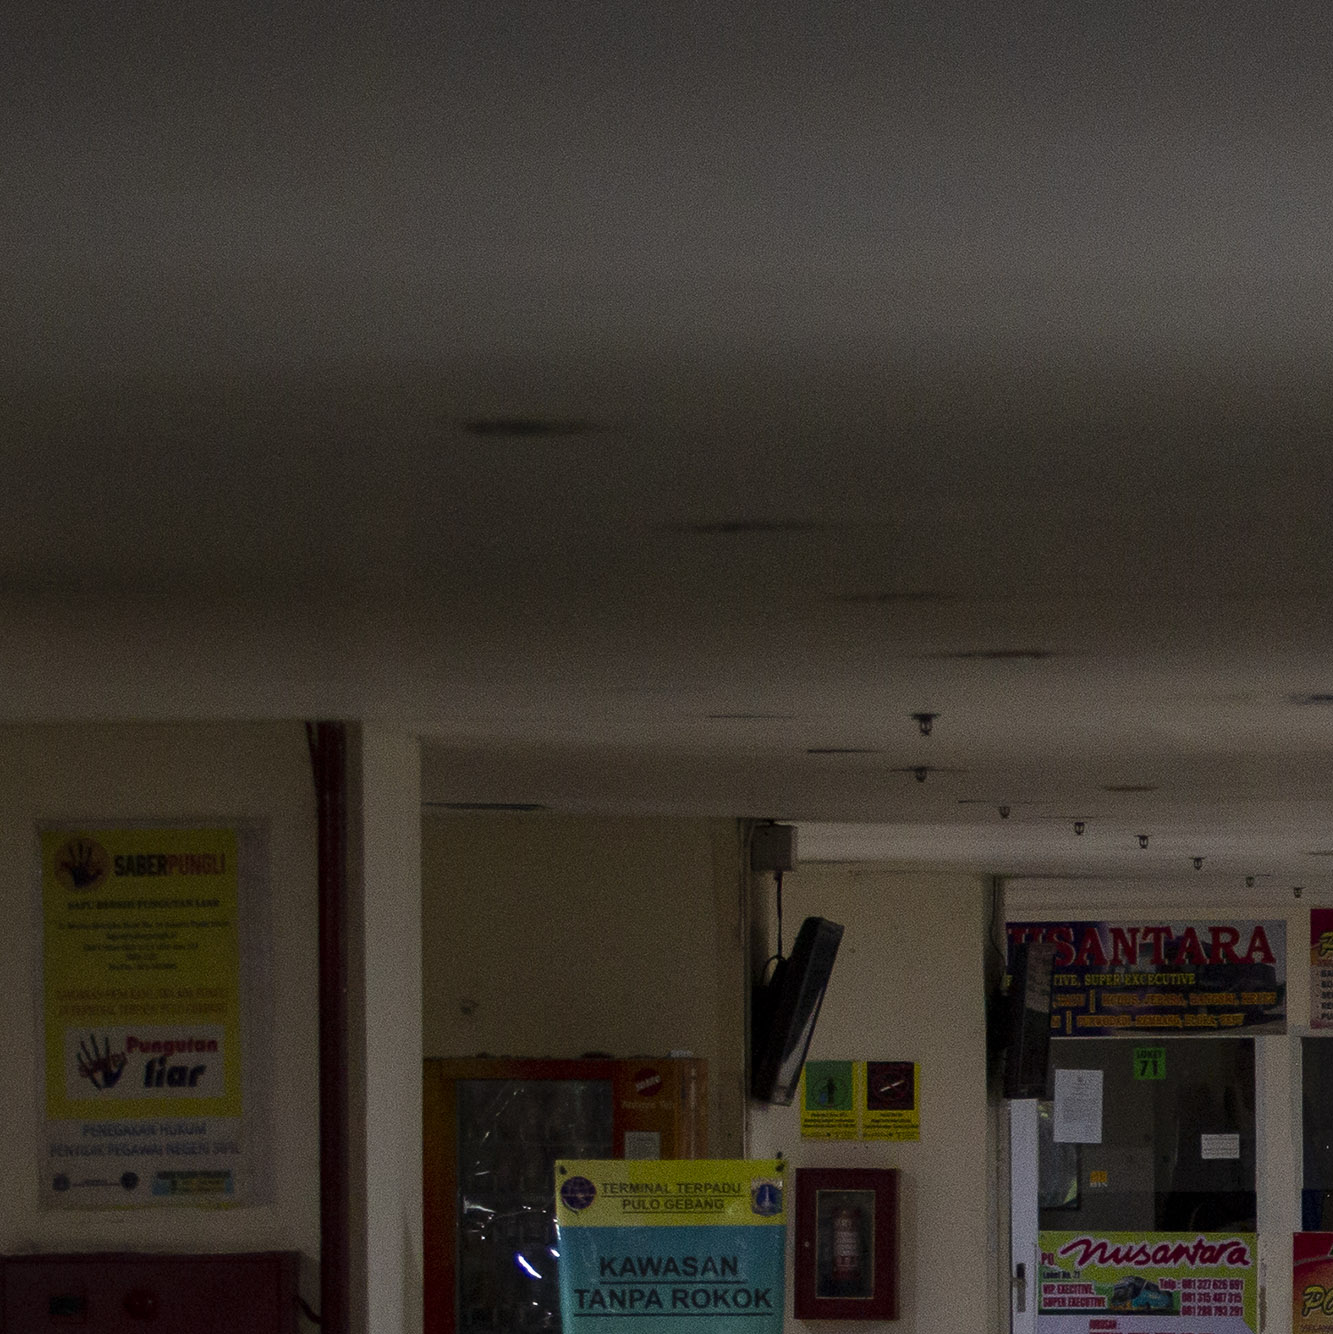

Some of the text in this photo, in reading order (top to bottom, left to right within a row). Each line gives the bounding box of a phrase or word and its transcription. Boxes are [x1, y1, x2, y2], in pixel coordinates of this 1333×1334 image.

[1008, 926, 1277, 967] SANTARA
[127, 1036, 218, 1056] Pungutan
[144, 1057, 206, 1088] liar
[1140, 1060, 1159, 1076] 71
[602, 1182, 742, 1195] TERMINAL TERPADU
[622, 1199, 725, 1211] PULO GEBANG
[600, 1255, 739, 1278] KAWASAN
[574, 1287, 773, 1310] TANPA ROKOK
